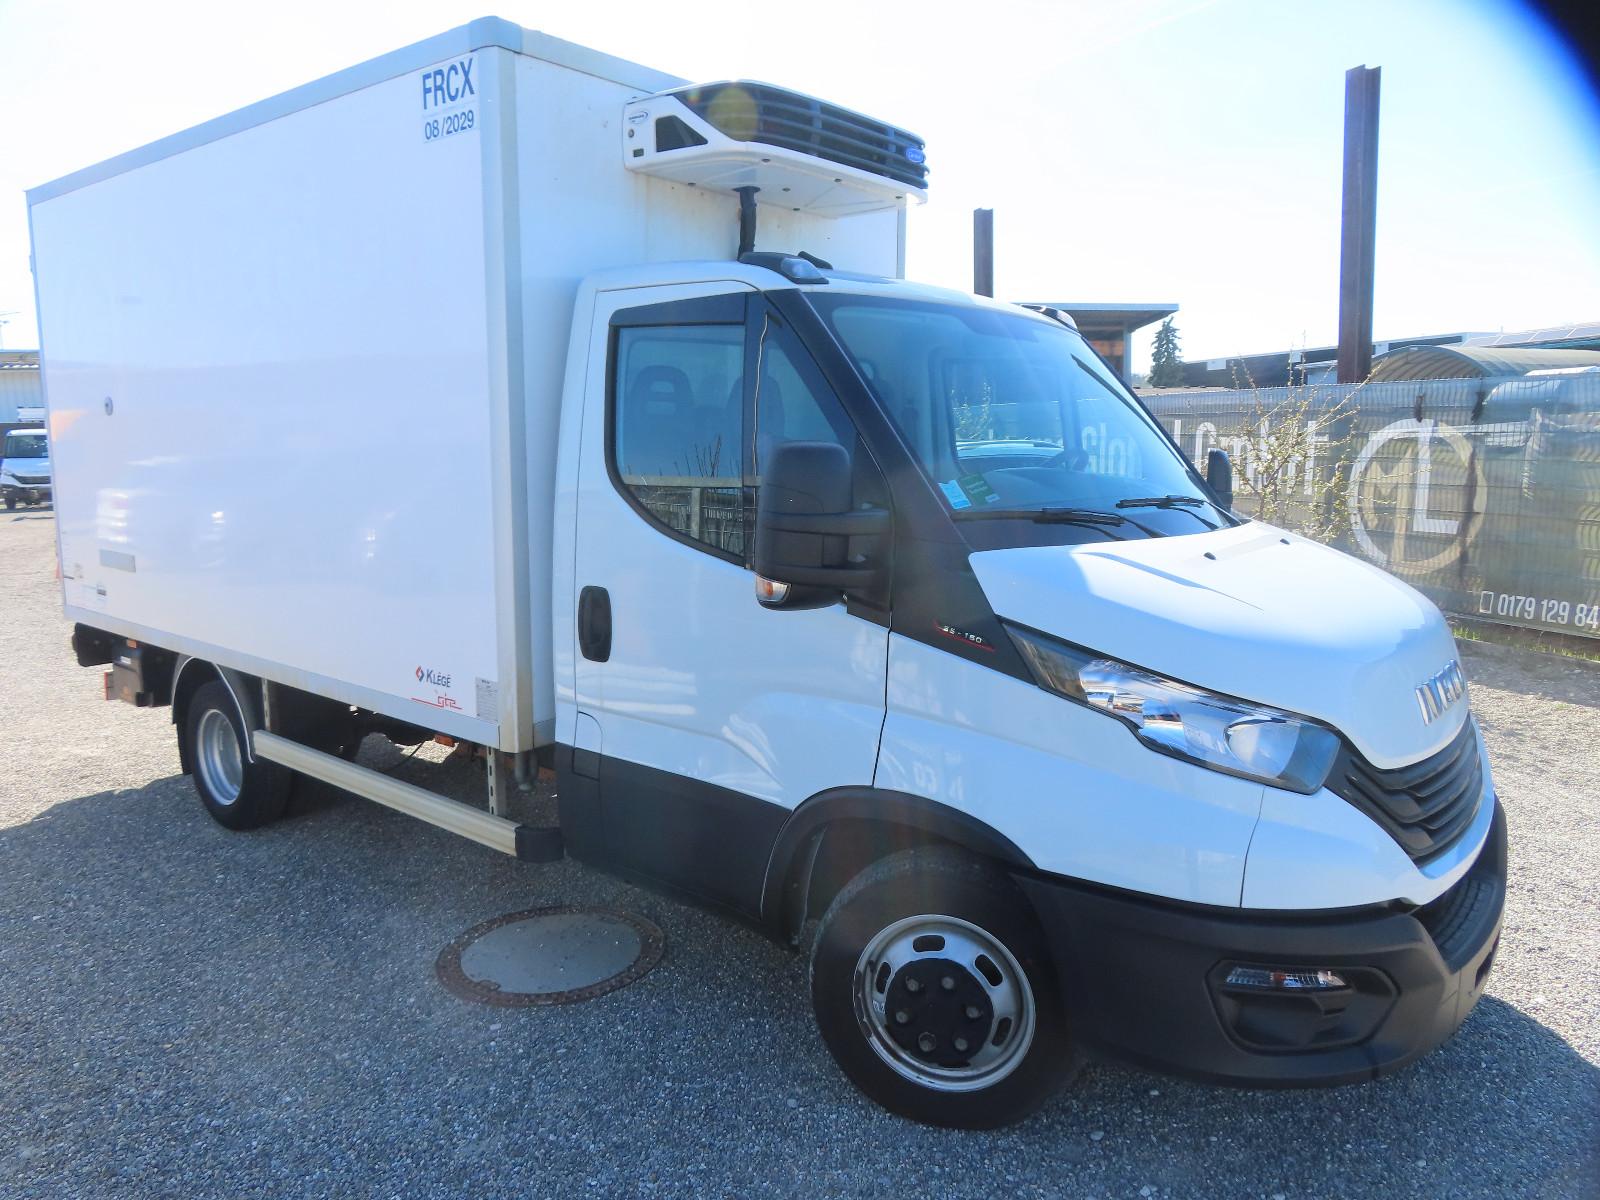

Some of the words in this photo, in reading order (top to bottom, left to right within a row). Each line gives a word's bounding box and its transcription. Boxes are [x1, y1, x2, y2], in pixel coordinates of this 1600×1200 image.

[422, 57, 475, 110] FRCX
[424, 109, 474, 140] 08/2029
[1498, 593, 1536, 620] 0179
[1541, 599, 1570, 625] 129
[1574, 603, 1600, 629] 84
